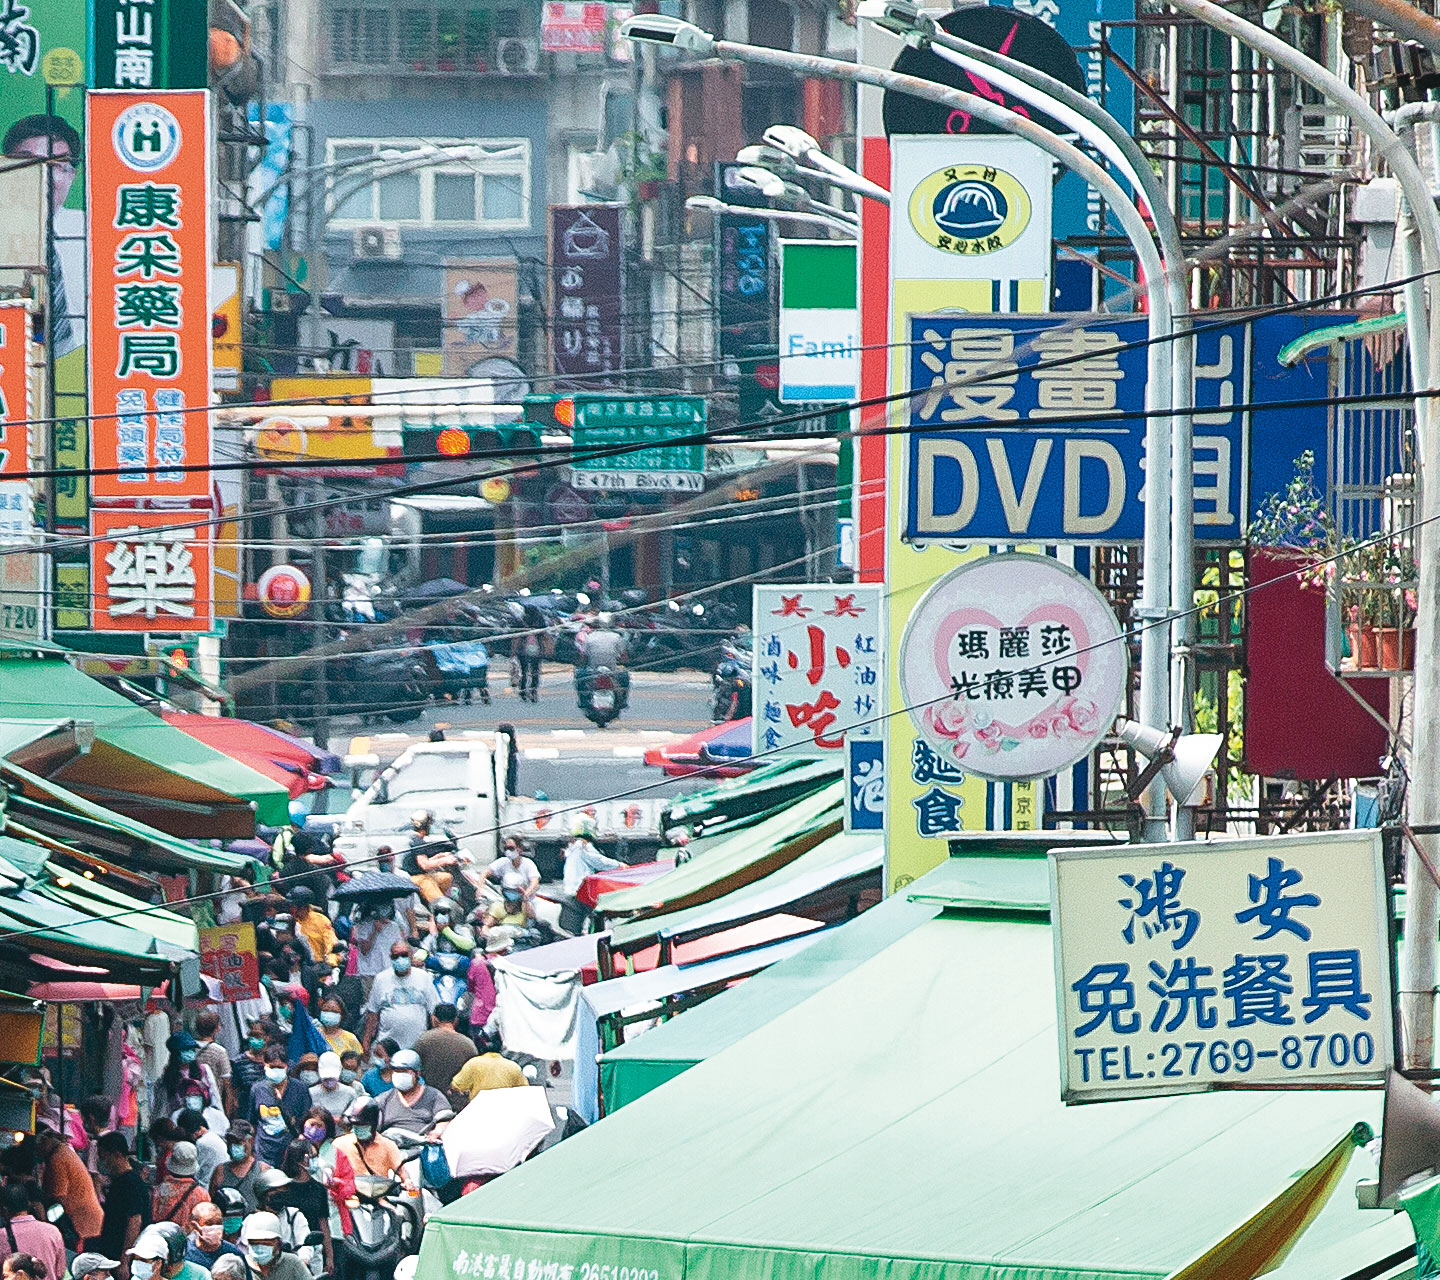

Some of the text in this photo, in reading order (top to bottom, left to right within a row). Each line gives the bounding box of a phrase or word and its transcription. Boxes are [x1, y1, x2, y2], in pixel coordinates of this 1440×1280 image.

[920, 326, 1128, 422] 漫畫
[917, 437, 1127, 535] DVD
[105, 525, 197, 619] 藥
[785, 624, 851, 750] 小吃
[949, 665, 1082, 702] 光療美甲
[957, 624, 1072, 660] 瑪麗莎
[1117, 856, 1322, 951] 鴻安
[1071, 948, 1374, 1039] 免洗餐具
[1075, 1030, 1375, 1083] TEL:2769-8700
